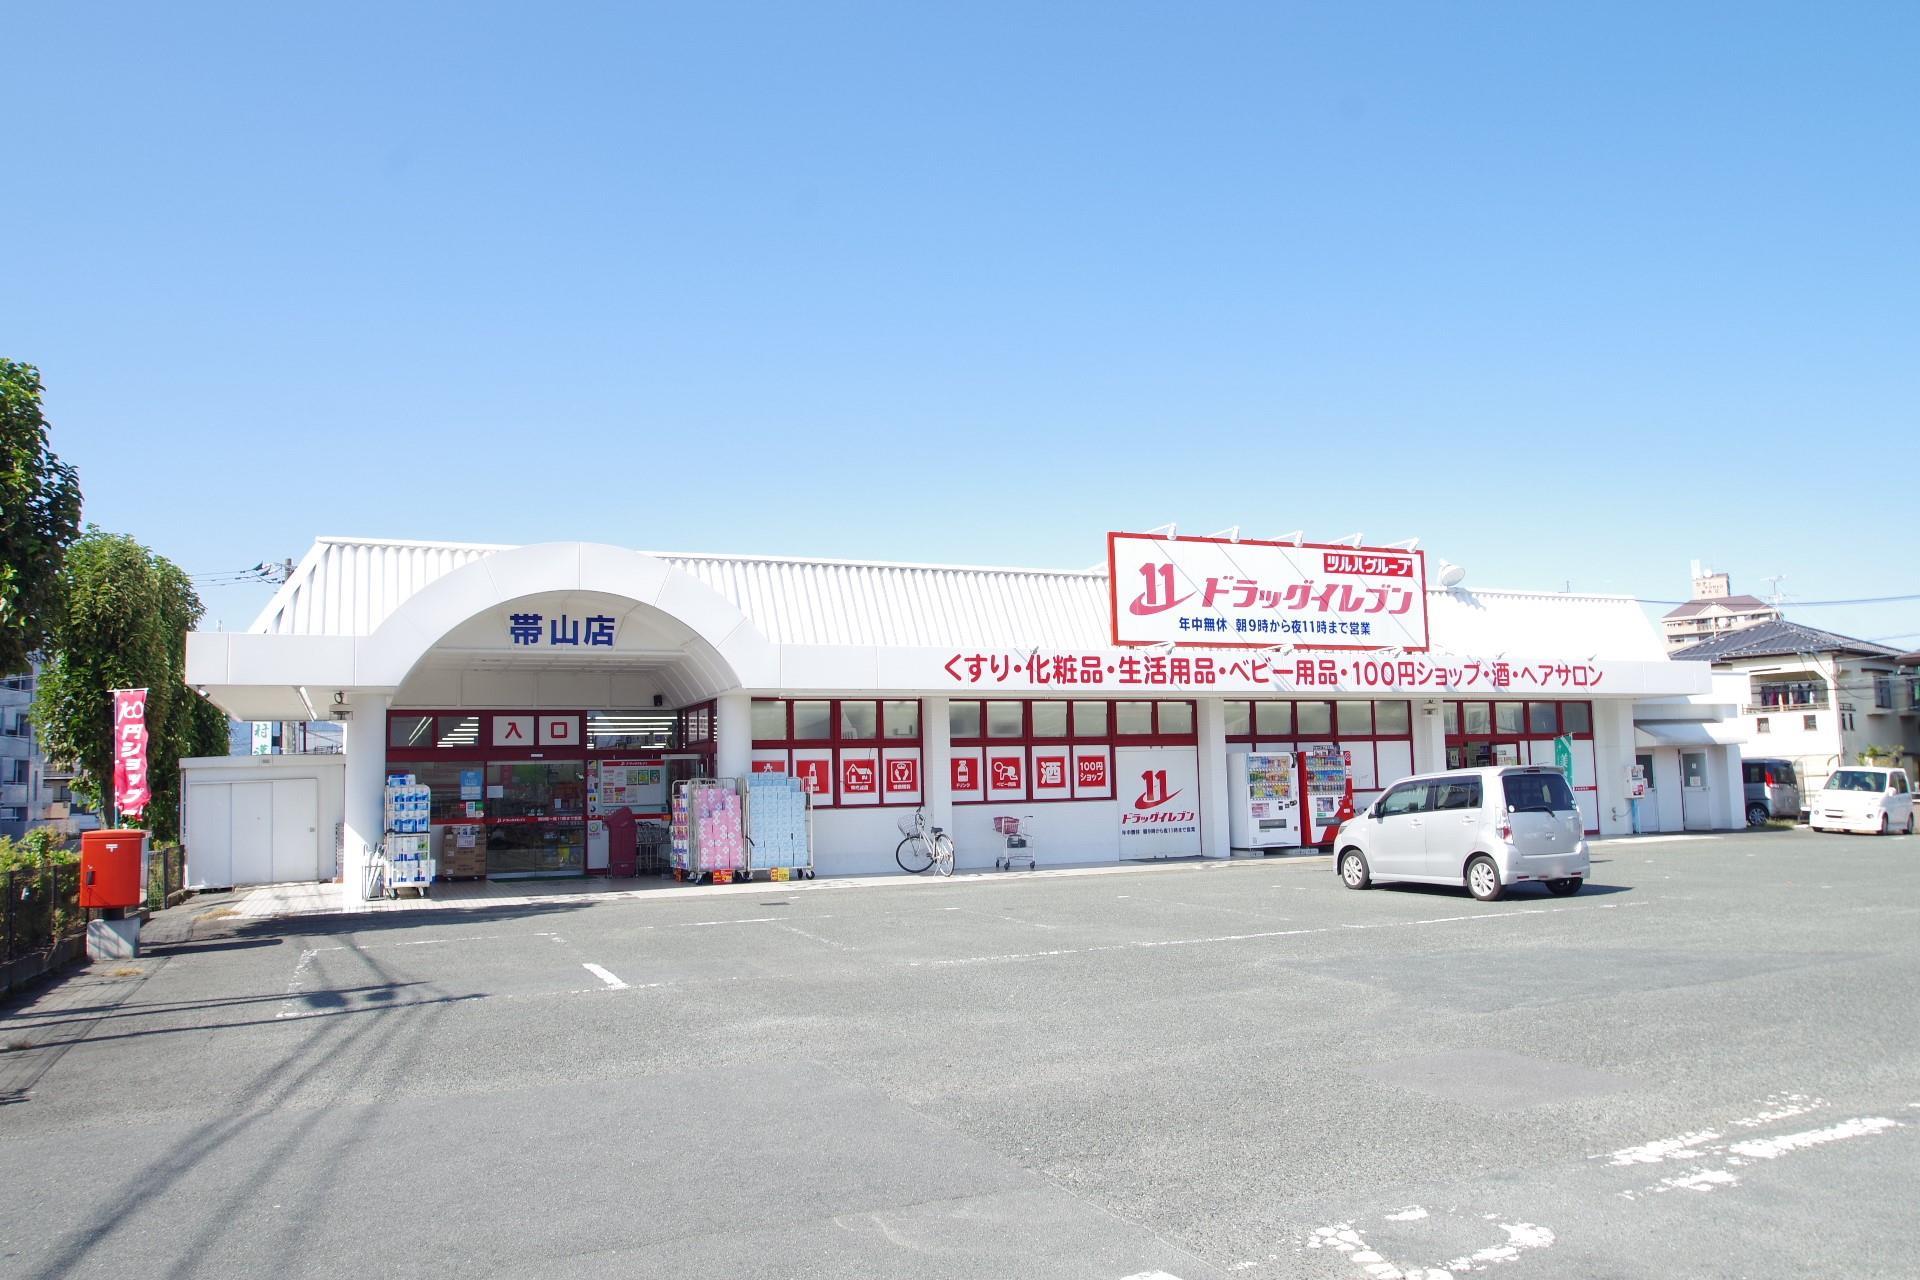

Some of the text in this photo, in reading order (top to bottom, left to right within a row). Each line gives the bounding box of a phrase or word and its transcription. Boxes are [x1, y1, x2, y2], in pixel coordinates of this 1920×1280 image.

[1327, 555, 1412, 575] ツルハグループ
[1135, 562, 1179, 610] 11
[1202, 575, 1413, 615] ドラッグイレブン
[510, 613, 615, 646] 帯山店
[1179, 616, 1371, 636] 年中無休 朝9時から夜11時まで営業
[505, 722, 568, 739] 入口
[1041, 761, 1061, 784] 酒
[1080, 762, 1103, 771] 100円
[1080, 771, 1103, 781] ショップ
[1138, 770, 1171, 804] 11
[1122, 811, 1195, 824] ドラッグイレブン
